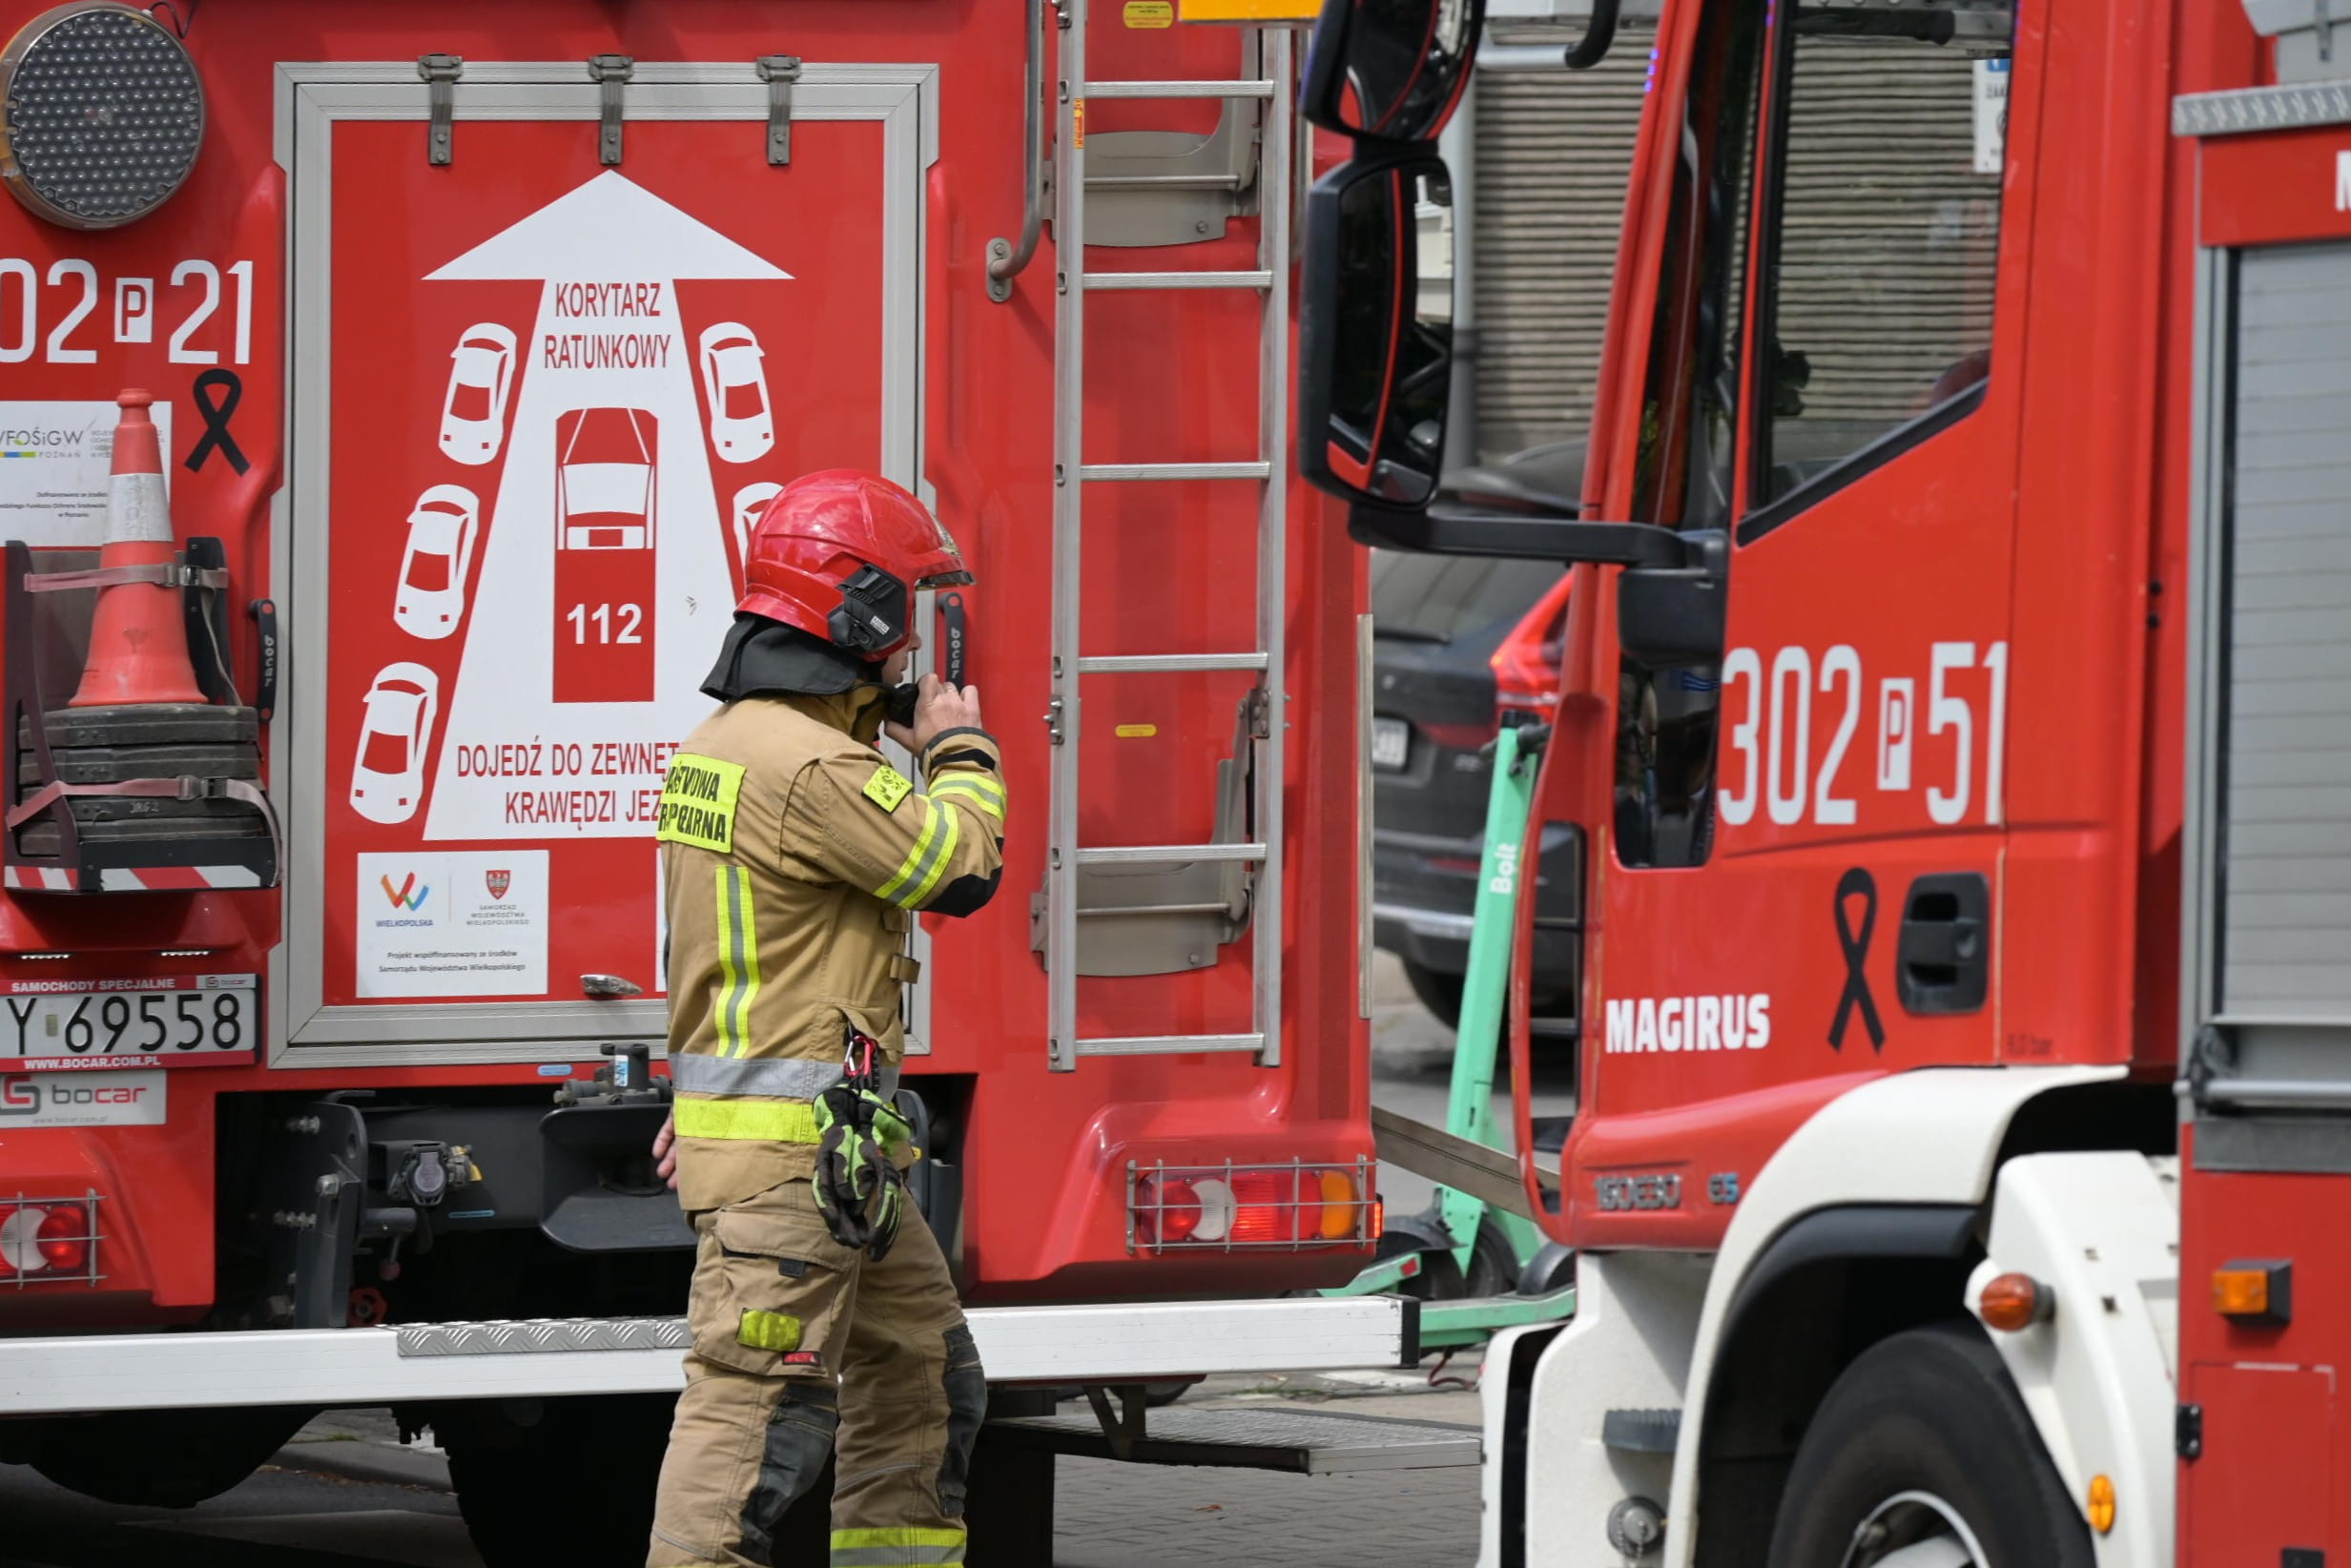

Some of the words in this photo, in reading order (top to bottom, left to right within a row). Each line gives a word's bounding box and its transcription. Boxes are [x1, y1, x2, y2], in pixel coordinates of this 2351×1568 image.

[169, 258, 253, 364] 21
[556, 282, 661, 318] KORYTARZ
[545, 334, 671, 369] RATUNKOWY
[567, 603, 642, 645] 112
[264, 634, 275, 687] bocar
[951, 627, 961, 679] bocar
[1718, 645, 1862, 825] 302
[1927, 641, 2008, 825] 51
[457, 734, 543, 777] DOJEDŹ
[551, 743, 582, 776] DO
[505, 789, 616, 831] KRAWĘDZI
[1490, 843, 1517, 895] Bolt
[376, 919, 433, 928] WIELKOPOLSKA
[11, 980, 95, 993] SAMOCHODY
[98, 978, 175, 991] SPECJALNE
[470, 963, 526, 972] Wielkopolskiego
[64, 992, 241, 1054] 69558
[1606, 994, 1770, 1053] MAGIRUS
[24, 1055, 161, 1069] WWW.BOCAR.COM.PL
[52, 1083, 147, 1104] bocar
